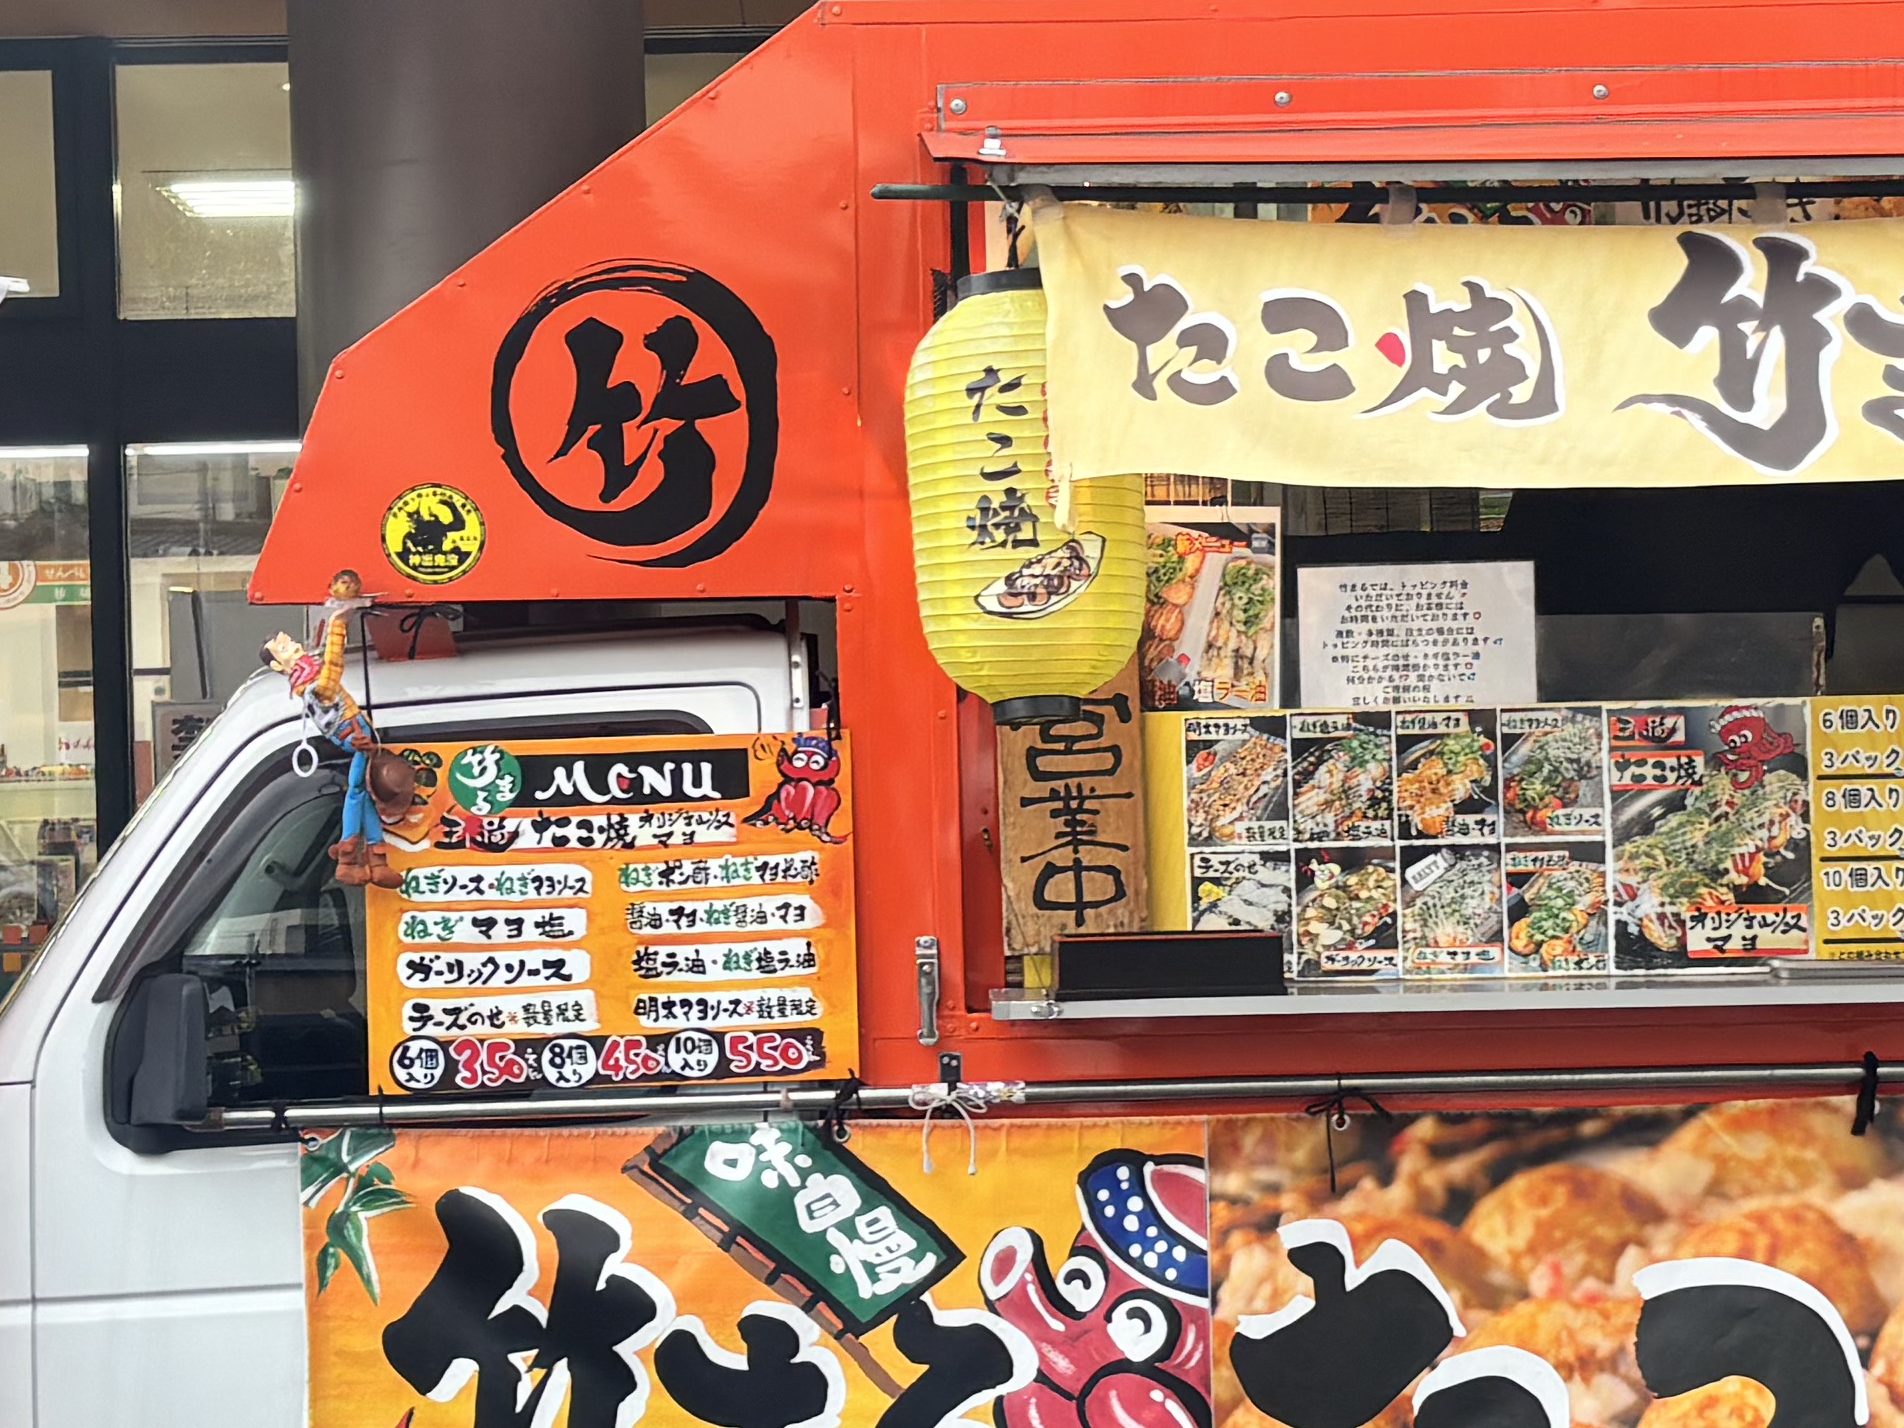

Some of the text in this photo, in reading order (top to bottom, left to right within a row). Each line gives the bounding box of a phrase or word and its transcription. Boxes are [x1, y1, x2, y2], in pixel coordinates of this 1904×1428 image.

[1104, 264, 1567, 428] たこ焼
[547, 315, 743, 548] 竹
[964, 364, 1041, 551] たこ焼
[1613, 753, 1704, 786] たこ焼
[405, 954, 573, 986] ガーリックソース
